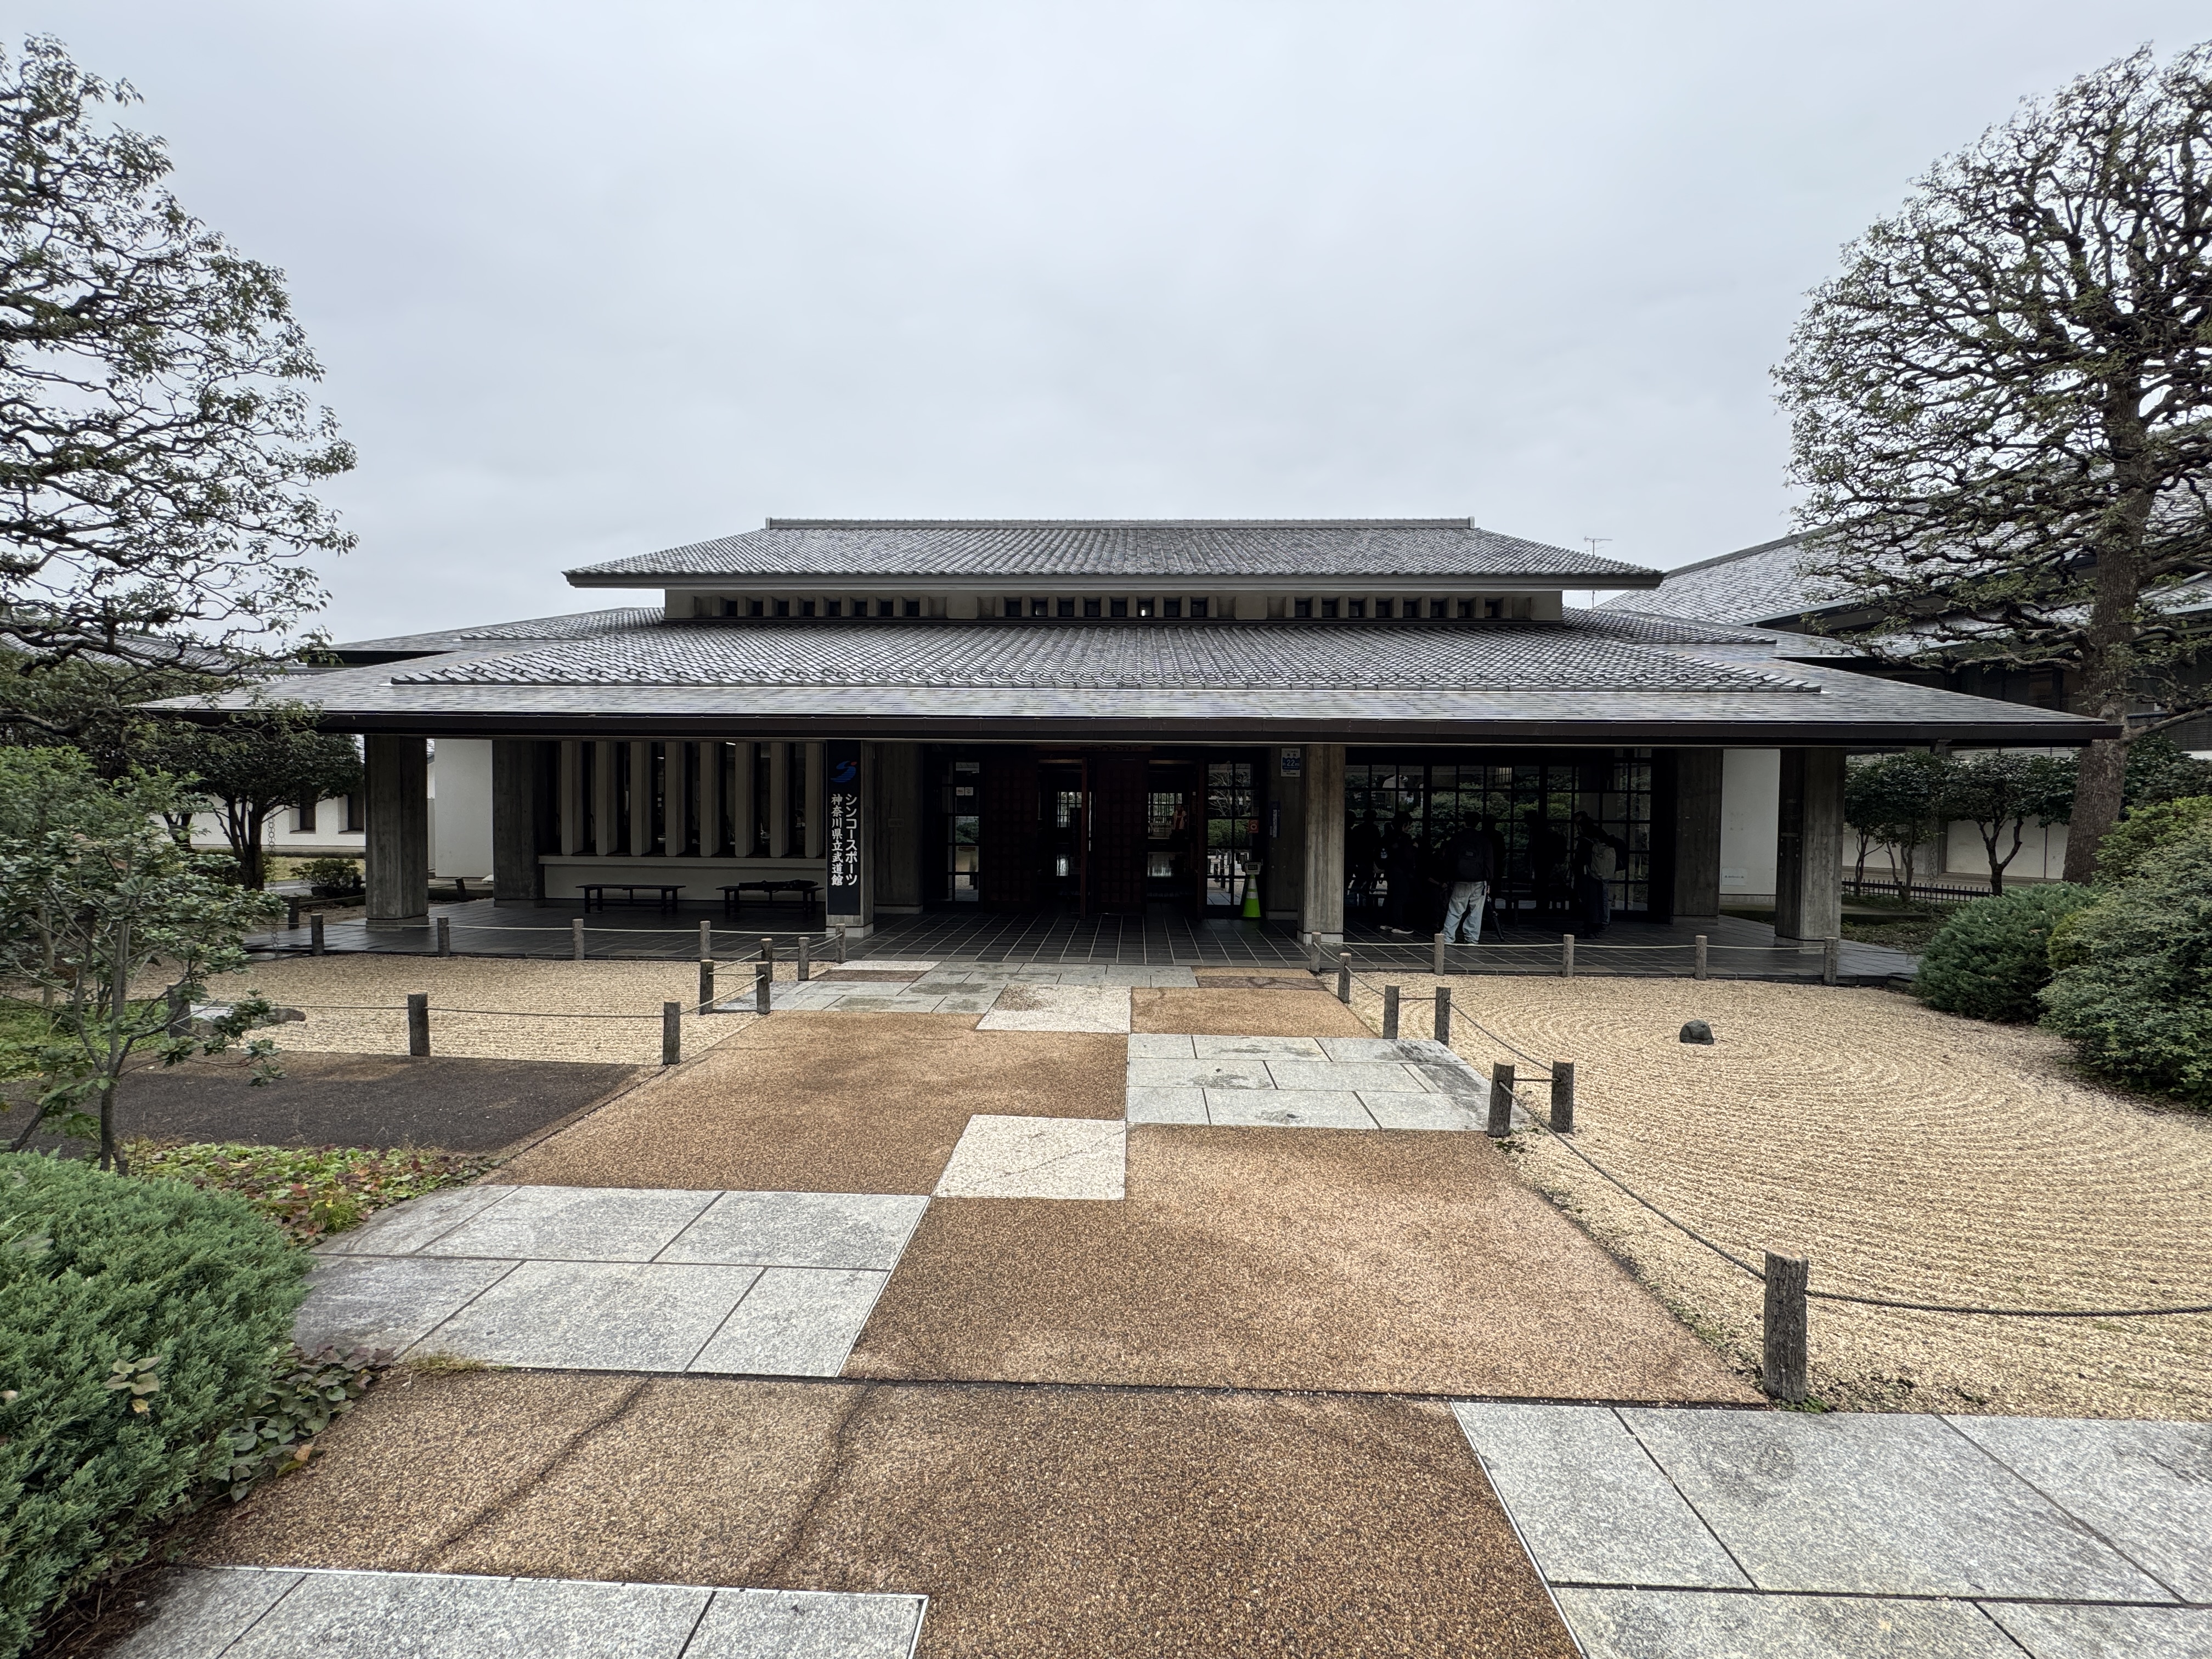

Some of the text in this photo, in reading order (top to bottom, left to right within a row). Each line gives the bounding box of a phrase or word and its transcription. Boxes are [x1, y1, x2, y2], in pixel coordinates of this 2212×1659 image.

[831, 793, 843, 886] 神奈川県立武道館
[845, 793, 857, 886] シンコースポーツ
